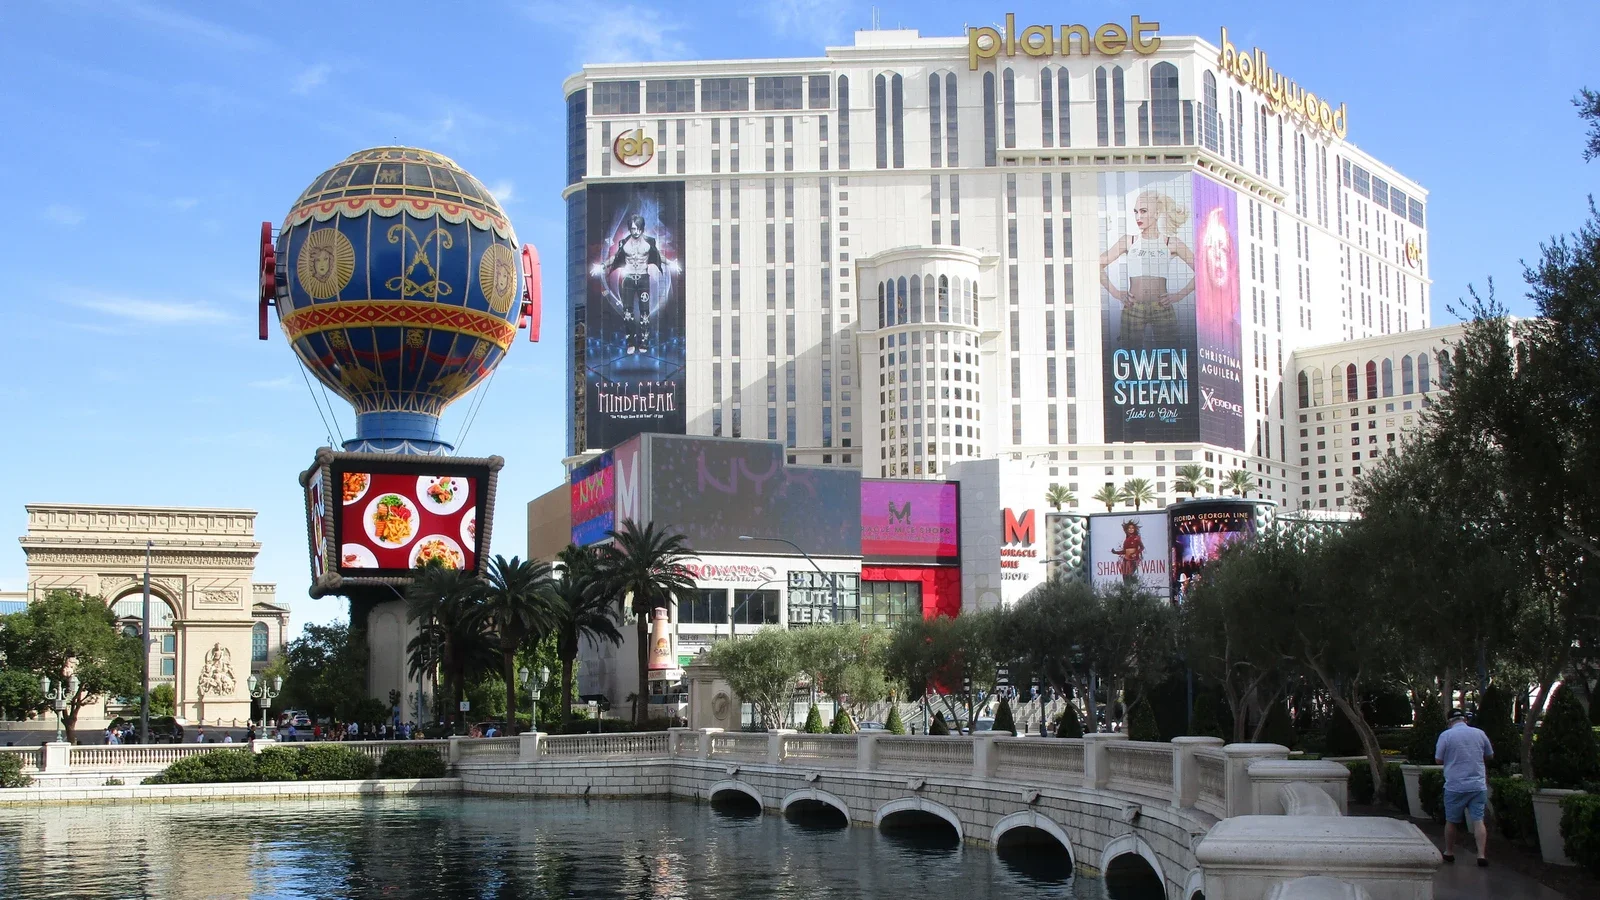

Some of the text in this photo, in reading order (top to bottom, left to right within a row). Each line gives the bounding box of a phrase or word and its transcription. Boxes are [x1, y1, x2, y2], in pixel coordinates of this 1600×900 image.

[968, 13, 1161, 71] planet
[1219, 26, 1348, 140] hollywood
[1113, 348, 1188, 381] GWEN
[1199, 347, 1242, 370] CHRISTINA
[1201, 363, 1241, 383] AGUILERA
[595, 381, 629, 389] CRISS
[1114, 380, 1189, 405] STEFANI
[1125, 407, 1179, 423] Just a Girl
[697, 450, 818, 495] NYX
[1003, 507, 1036, 544] M
[1174, 514, 1196, 522] FLORIDA
[1198, 512, 1231, 520] GEORGIA
[1000, 548, 1037, 558] MIRACLE
[1000, 560, 1020, 569] MILE
[1136, 559, 1166, 575] WAIN
[790, 572, 847, 588] URBAN
[790, 591, 850, 606] OUTFIT
